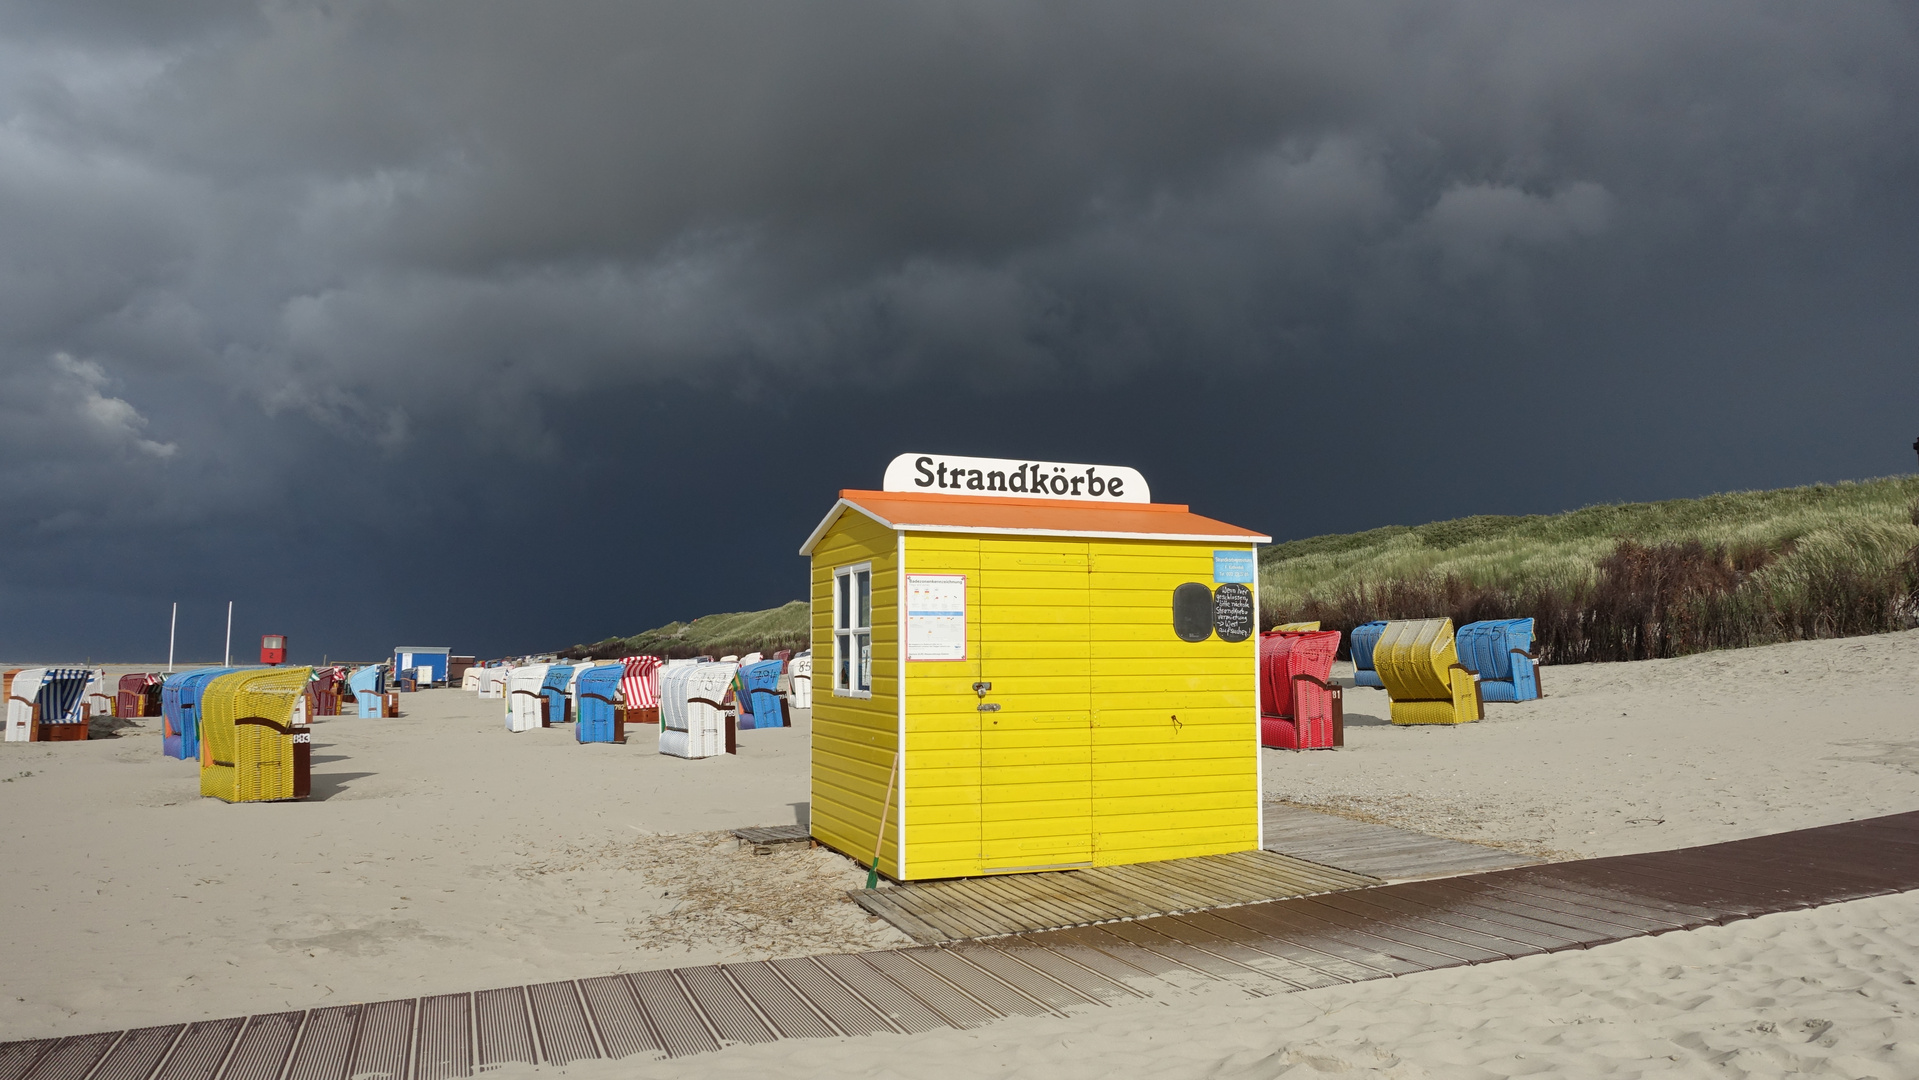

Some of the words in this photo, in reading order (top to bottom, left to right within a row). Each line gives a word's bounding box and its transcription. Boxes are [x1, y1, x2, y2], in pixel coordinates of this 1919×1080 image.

[914, 456, 1124, 498] Strandkörbe
[1236, 584, 1249, 595] hier
[1460, 625, 1500, 642] 775
[753, 670, 778, 685] 794
